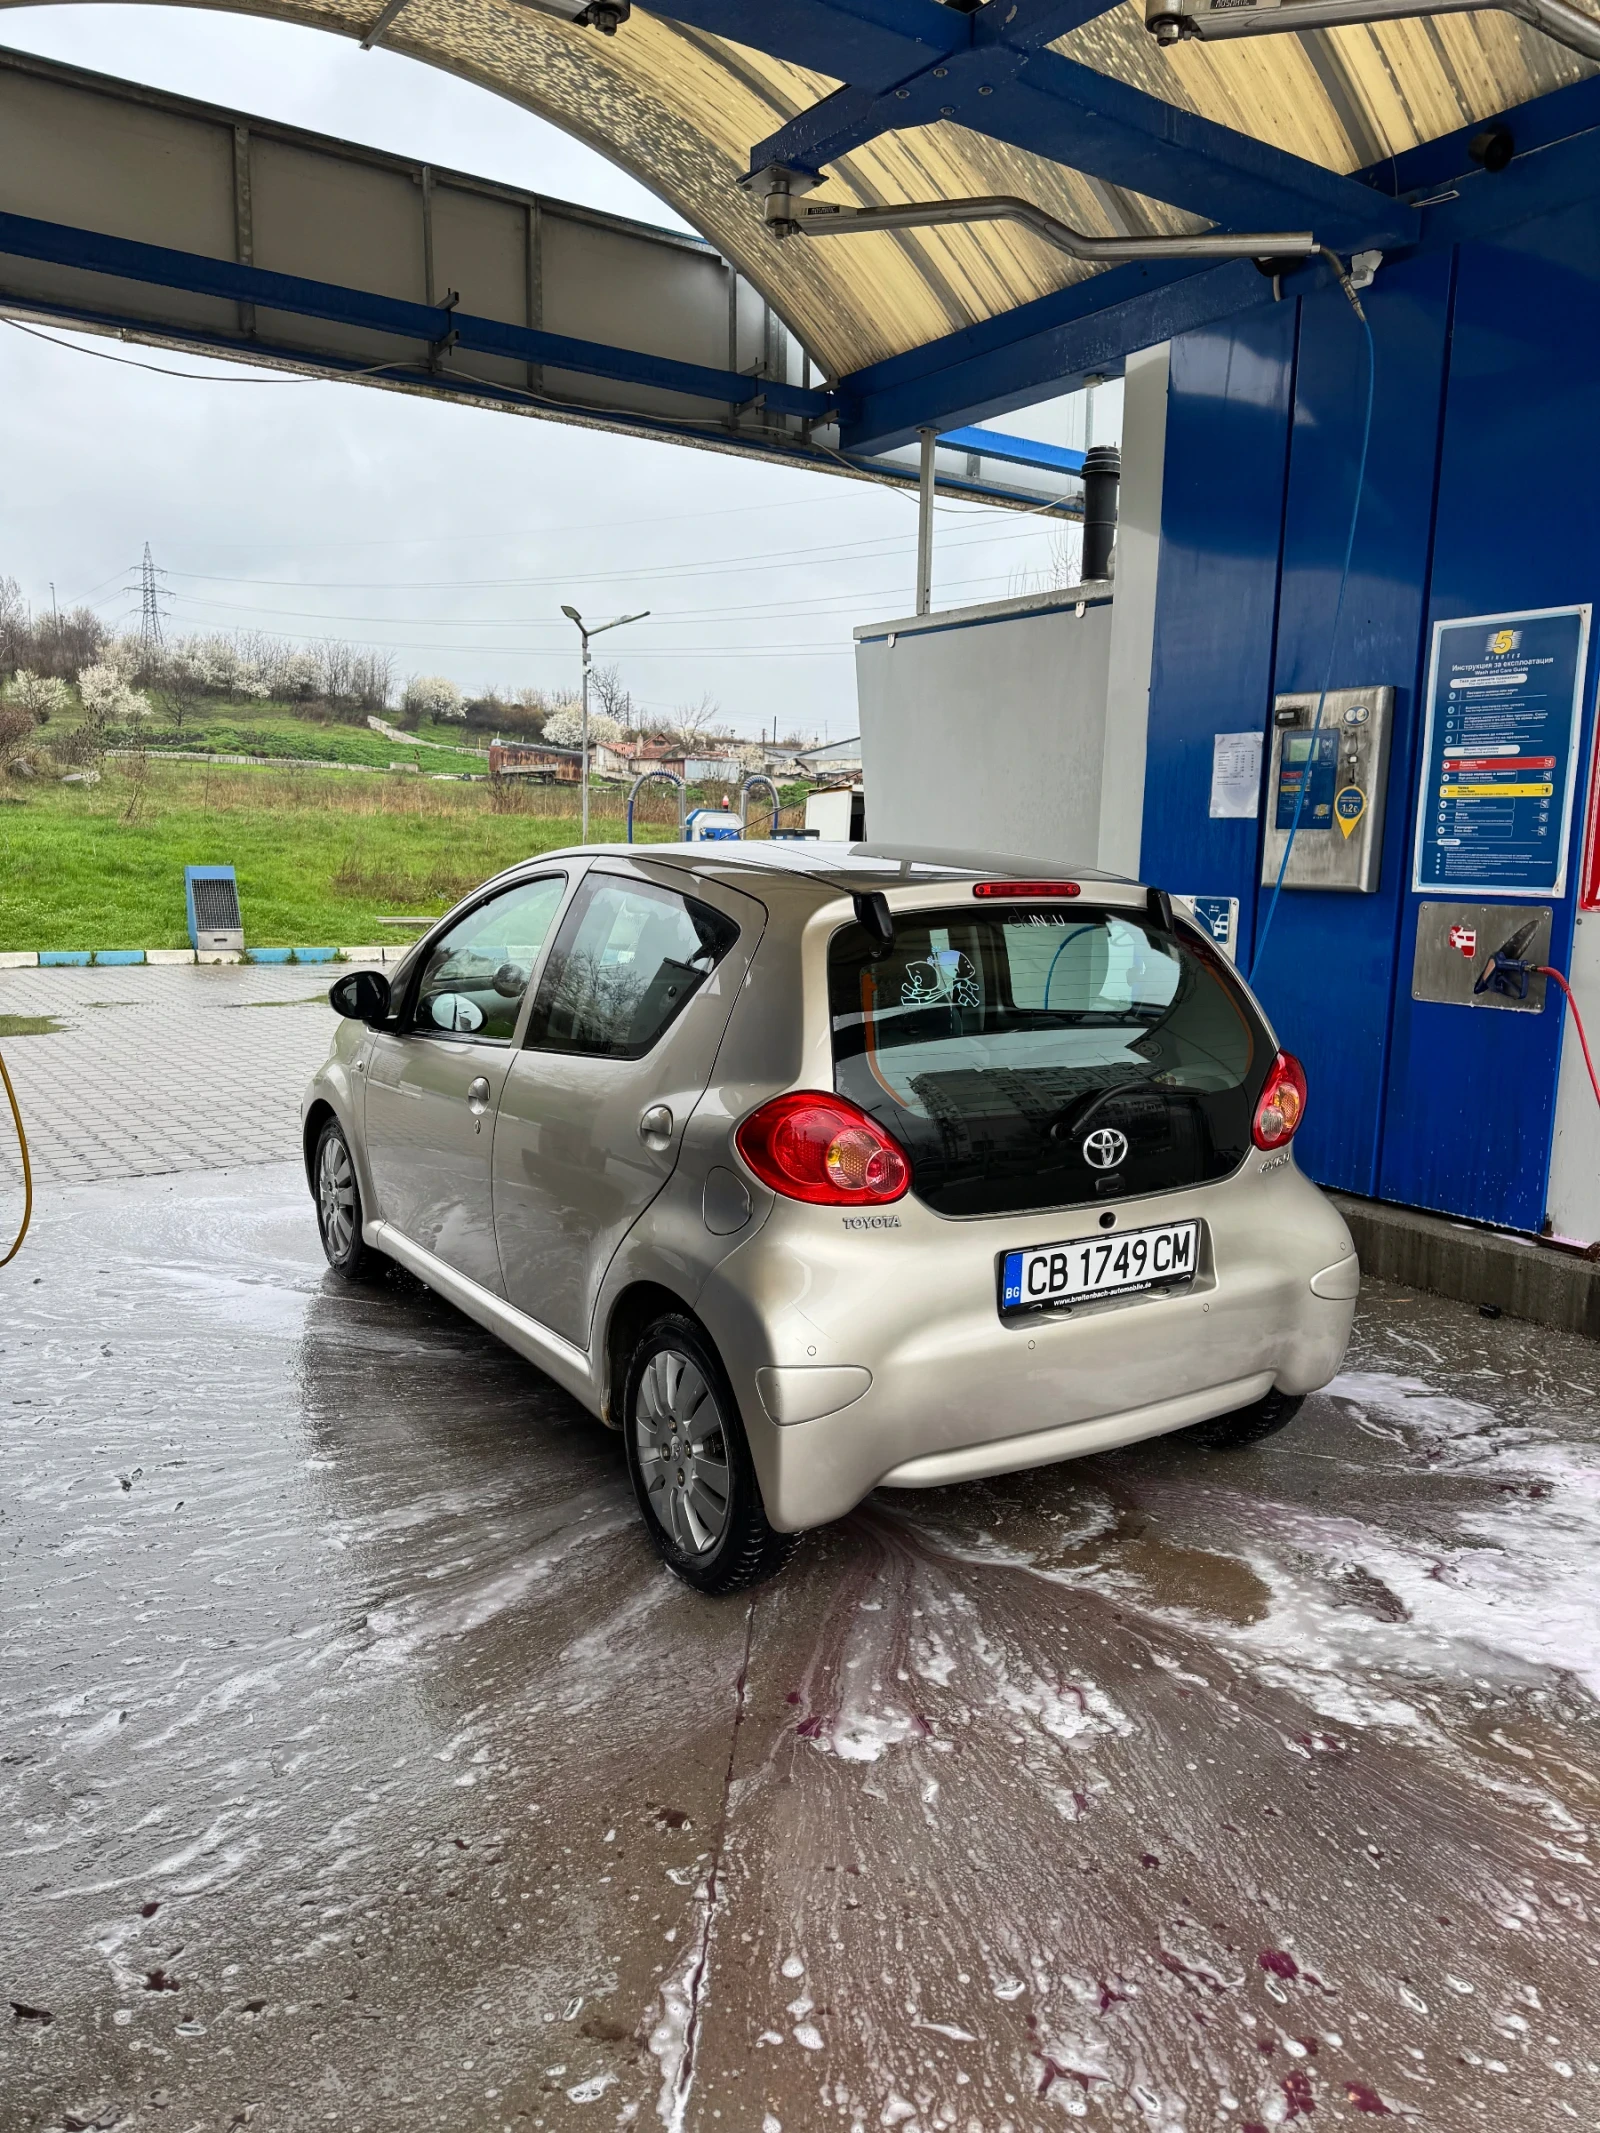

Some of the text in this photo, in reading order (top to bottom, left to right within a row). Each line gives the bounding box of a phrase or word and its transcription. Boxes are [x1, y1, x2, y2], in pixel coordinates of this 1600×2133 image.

[1492, 629, 1514, 655] 5
[1451, 662, 1493, 672] Инструкция
[842, 1215, 902, 1230] TOYOTA
[1027, 1231, 1190, 1295] CB 1749 CM
[1005, 1286, 1020, 1299] BG
